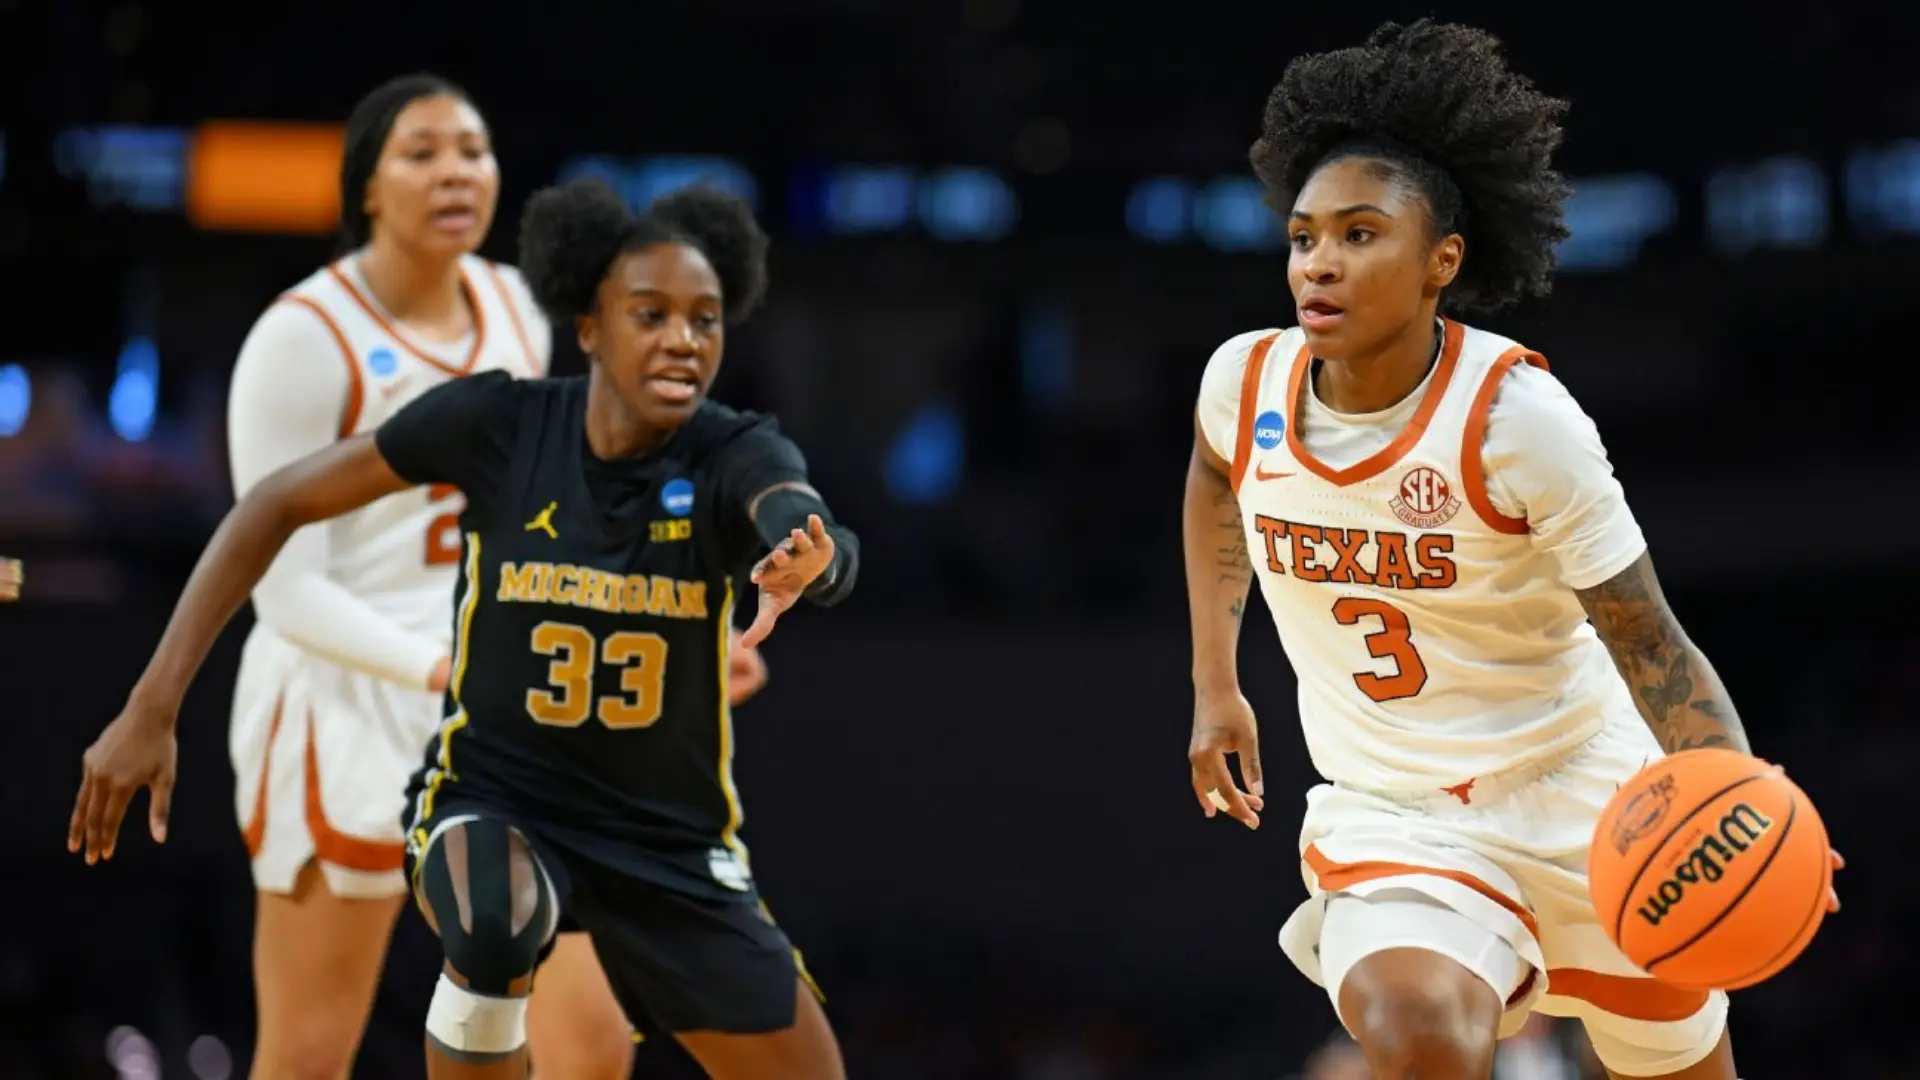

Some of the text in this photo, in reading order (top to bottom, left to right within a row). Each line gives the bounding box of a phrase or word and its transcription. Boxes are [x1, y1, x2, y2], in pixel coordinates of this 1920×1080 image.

[1398, 504, 1452, 527] GRADUATE
[1402, 468, 1447, 513] SEC
[1255, 514, 1457, 589] TEXAS
[497, 561, 707, 619] MICHIGAN
[526, 621, 668, 730] 33
[1331, 597, 1428, 702] 3
[1637, 802, 1772, 926] Wilson
